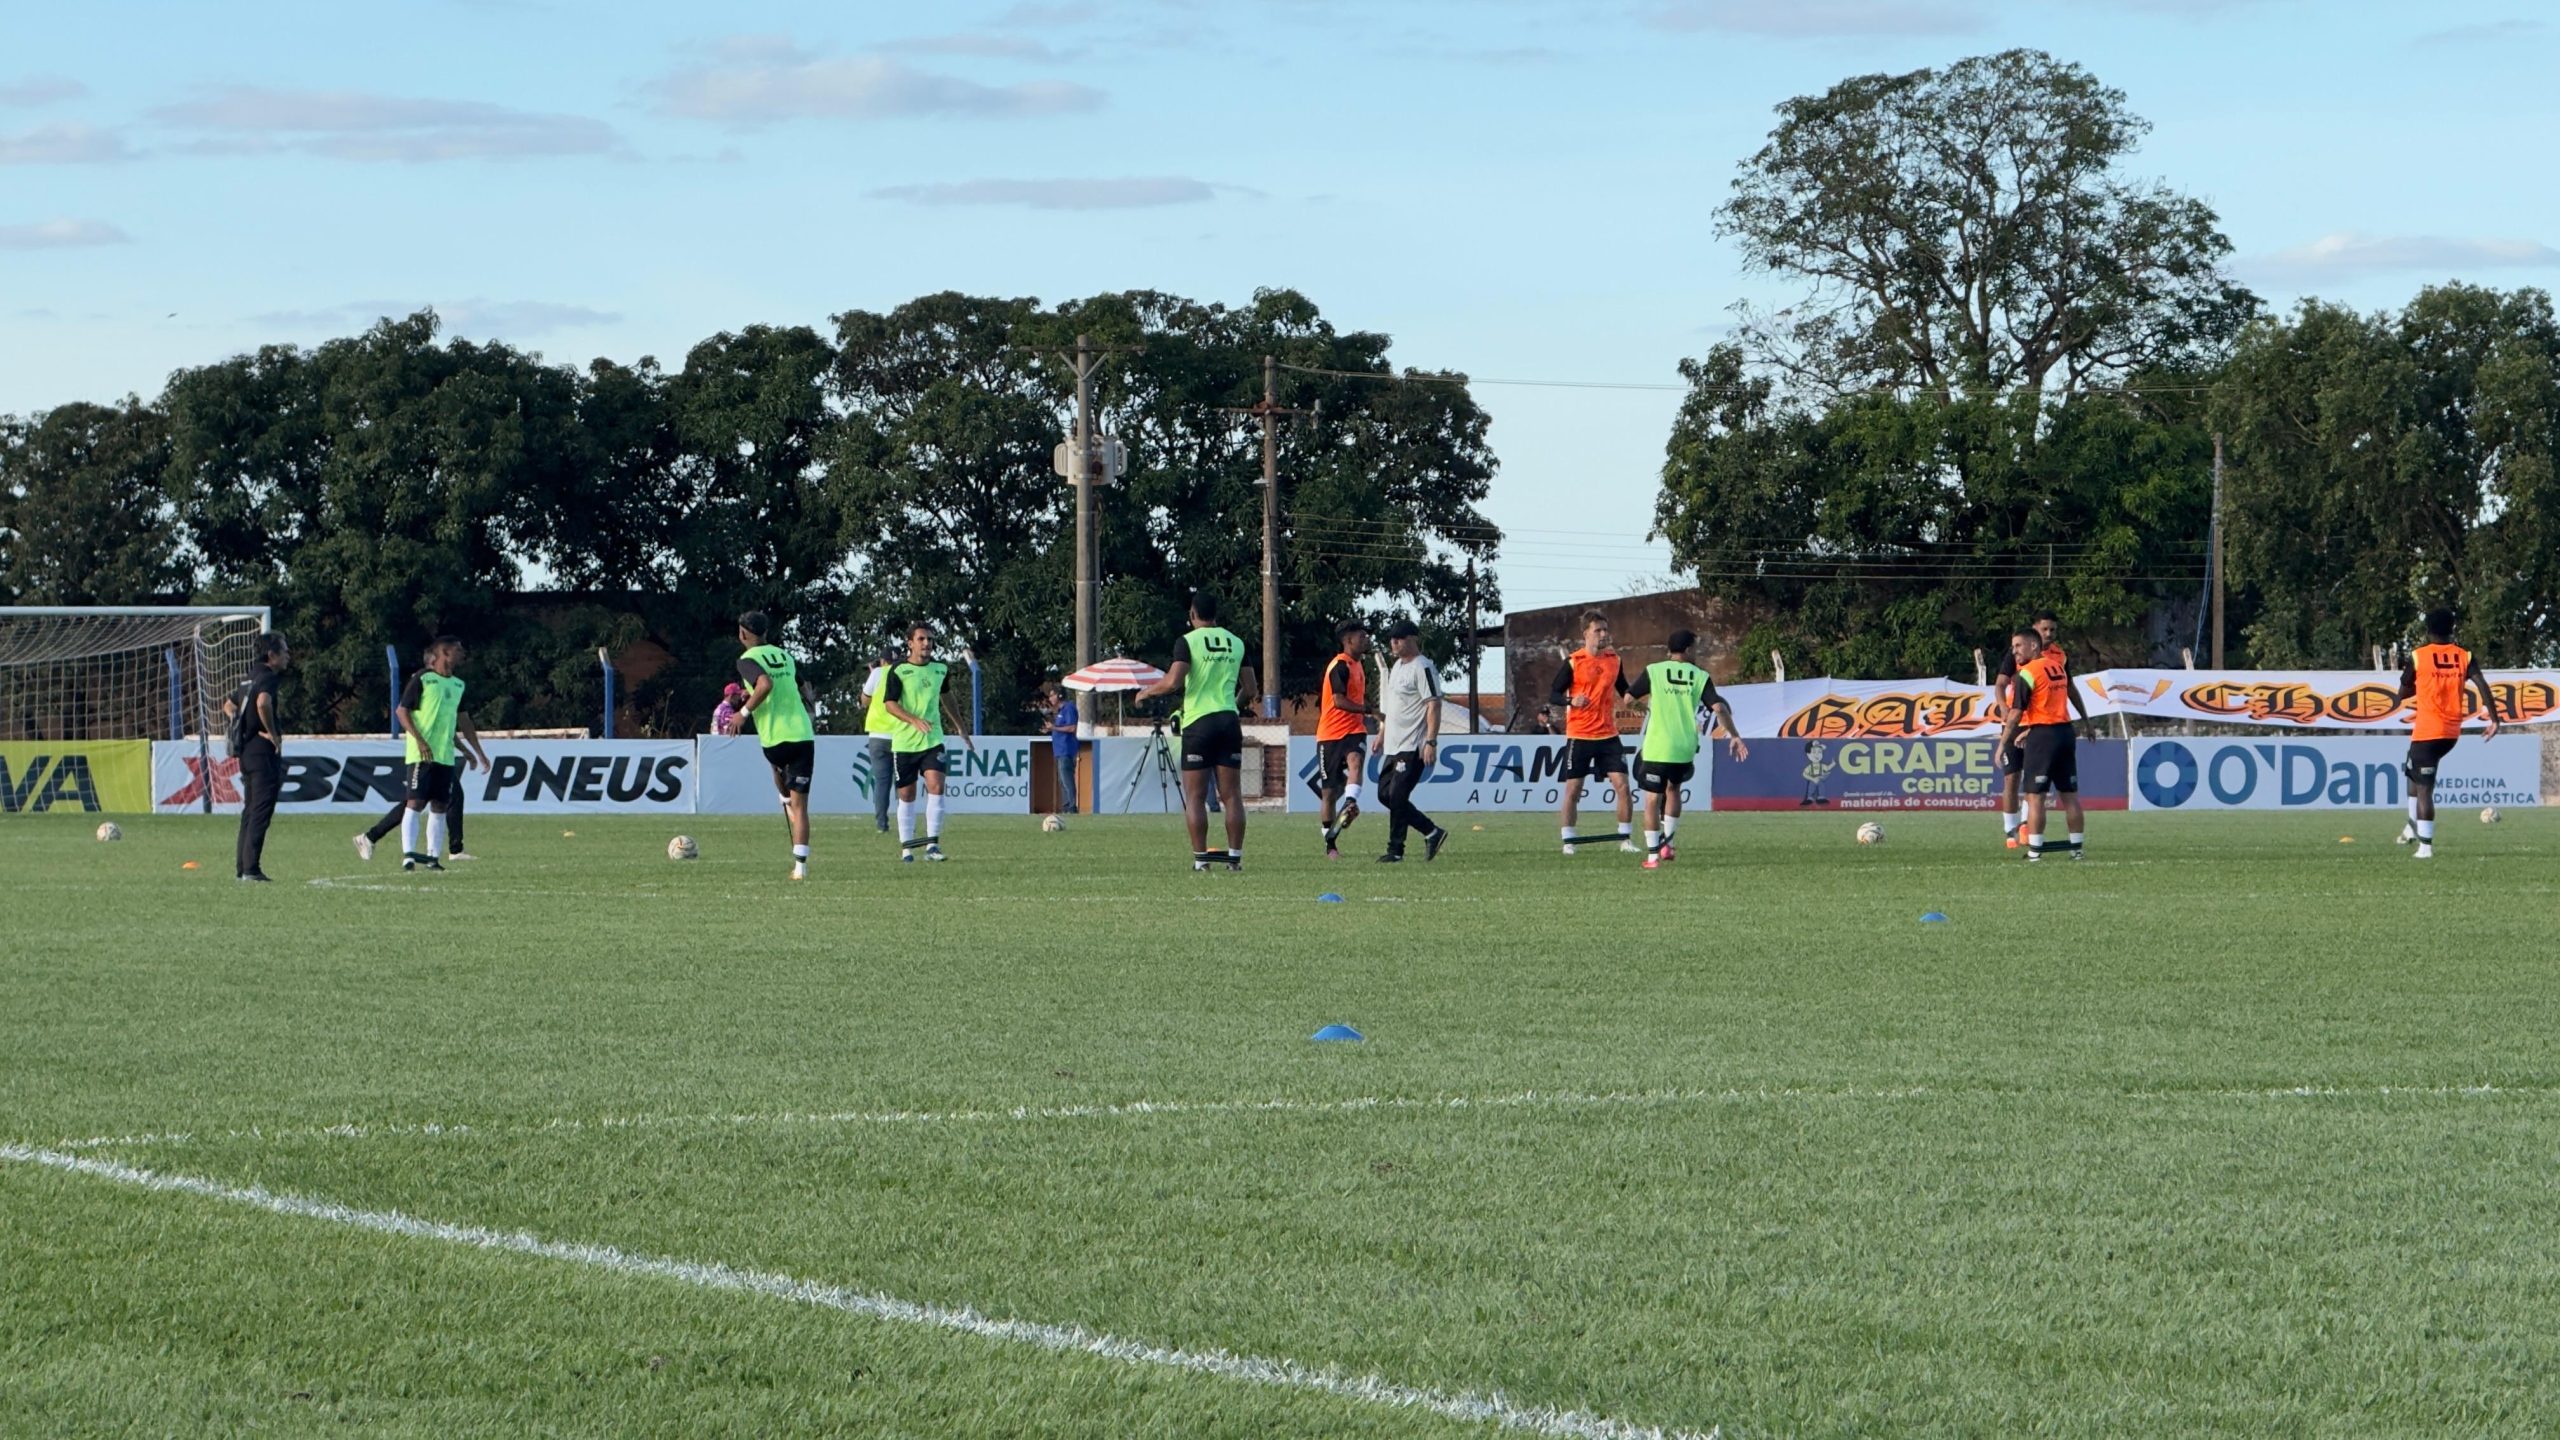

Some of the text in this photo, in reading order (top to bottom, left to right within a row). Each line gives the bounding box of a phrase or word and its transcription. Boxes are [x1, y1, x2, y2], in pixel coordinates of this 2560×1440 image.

[944, 749, 1028, 777] ENAR
[1838, 742, 1994, 774] GRAPE
[482, 754, 689, 803] PNEUS
[1902, 774, 1994, 794] center
[2434, 777, 2507, 789] MEDICINA
[964, 782, 1015, 798] Grosso
[1467, 788, 1692, 805] AUTO POSO
[2433, 790, 2536, 804] DIAGNÓSTICA
[1841, 796, 1996, 809] materiais de construção
